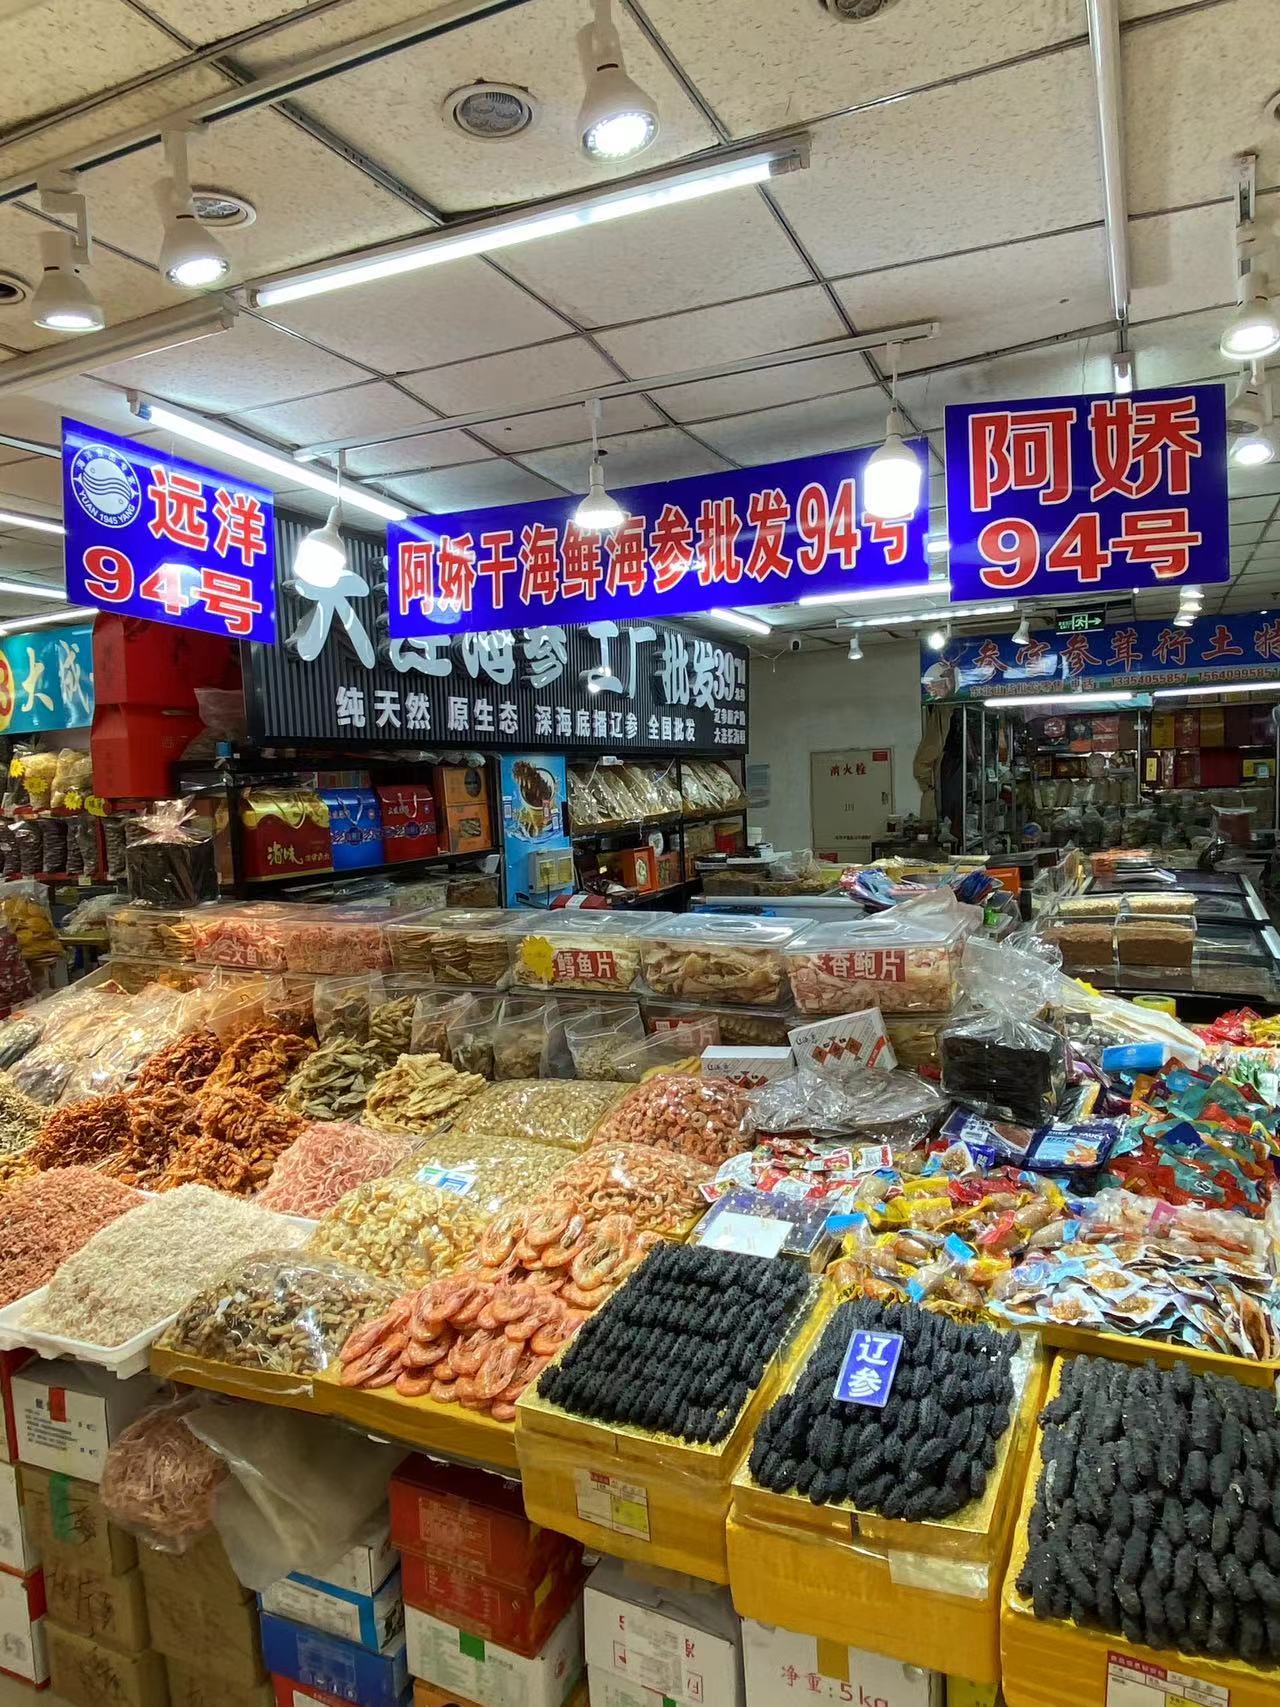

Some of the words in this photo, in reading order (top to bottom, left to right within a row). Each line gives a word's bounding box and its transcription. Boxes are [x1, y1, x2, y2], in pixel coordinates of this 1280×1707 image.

[968, 396, 1201, 512] 阿娇
[79, 489, 99, 517] YUAN
[99, 513, 118, 525] 1945
[117, 503, 136, 523] YANG
[147, 464, 266, 567] 远洋
[978, 508, 1201, 589] 94号
[83, 545, 262, 635] 94号
[335, 686, 431, 731] 纯天然
[447, 695, 519, 735] 原生态
[534, 704, 638, 740] 深海底播辽参
[647, 714, 696, 742] 全国批发
[830, 762, 867, 777] 消火栓
[552, 952, 612, 978] 鳕鱼片
[848, 1335, 892, 1398] 辽参
